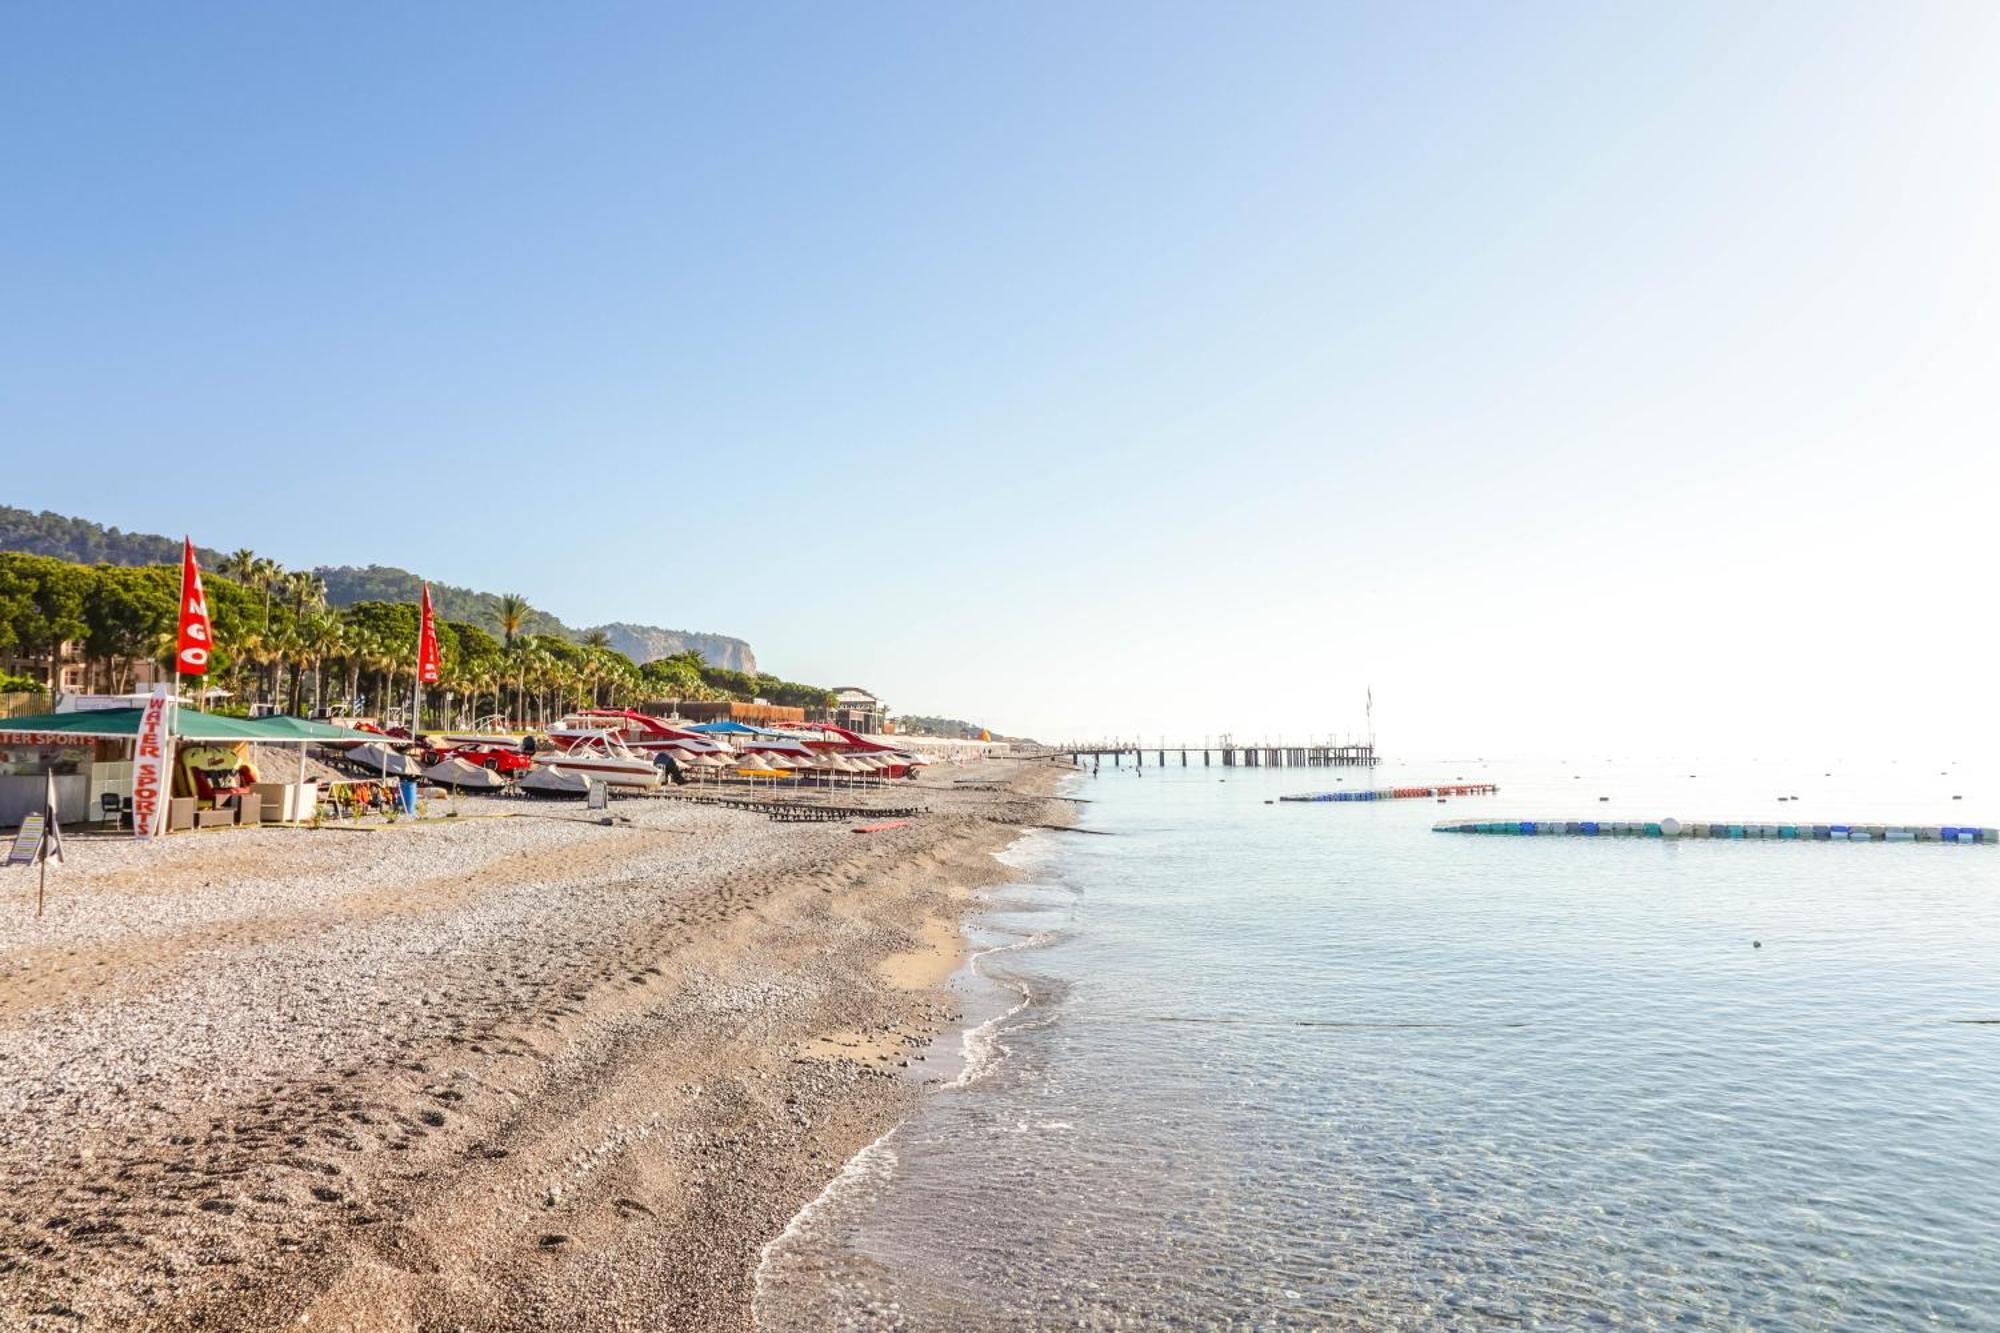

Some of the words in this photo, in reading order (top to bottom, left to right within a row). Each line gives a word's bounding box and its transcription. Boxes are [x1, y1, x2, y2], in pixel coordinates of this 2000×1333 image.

[0, 733, 33, 745] TER
[36, 734, 96, 746] SPORTS
[139, 698, 164, 758] WATER
[134, 764, 157, 836] SPORTS
